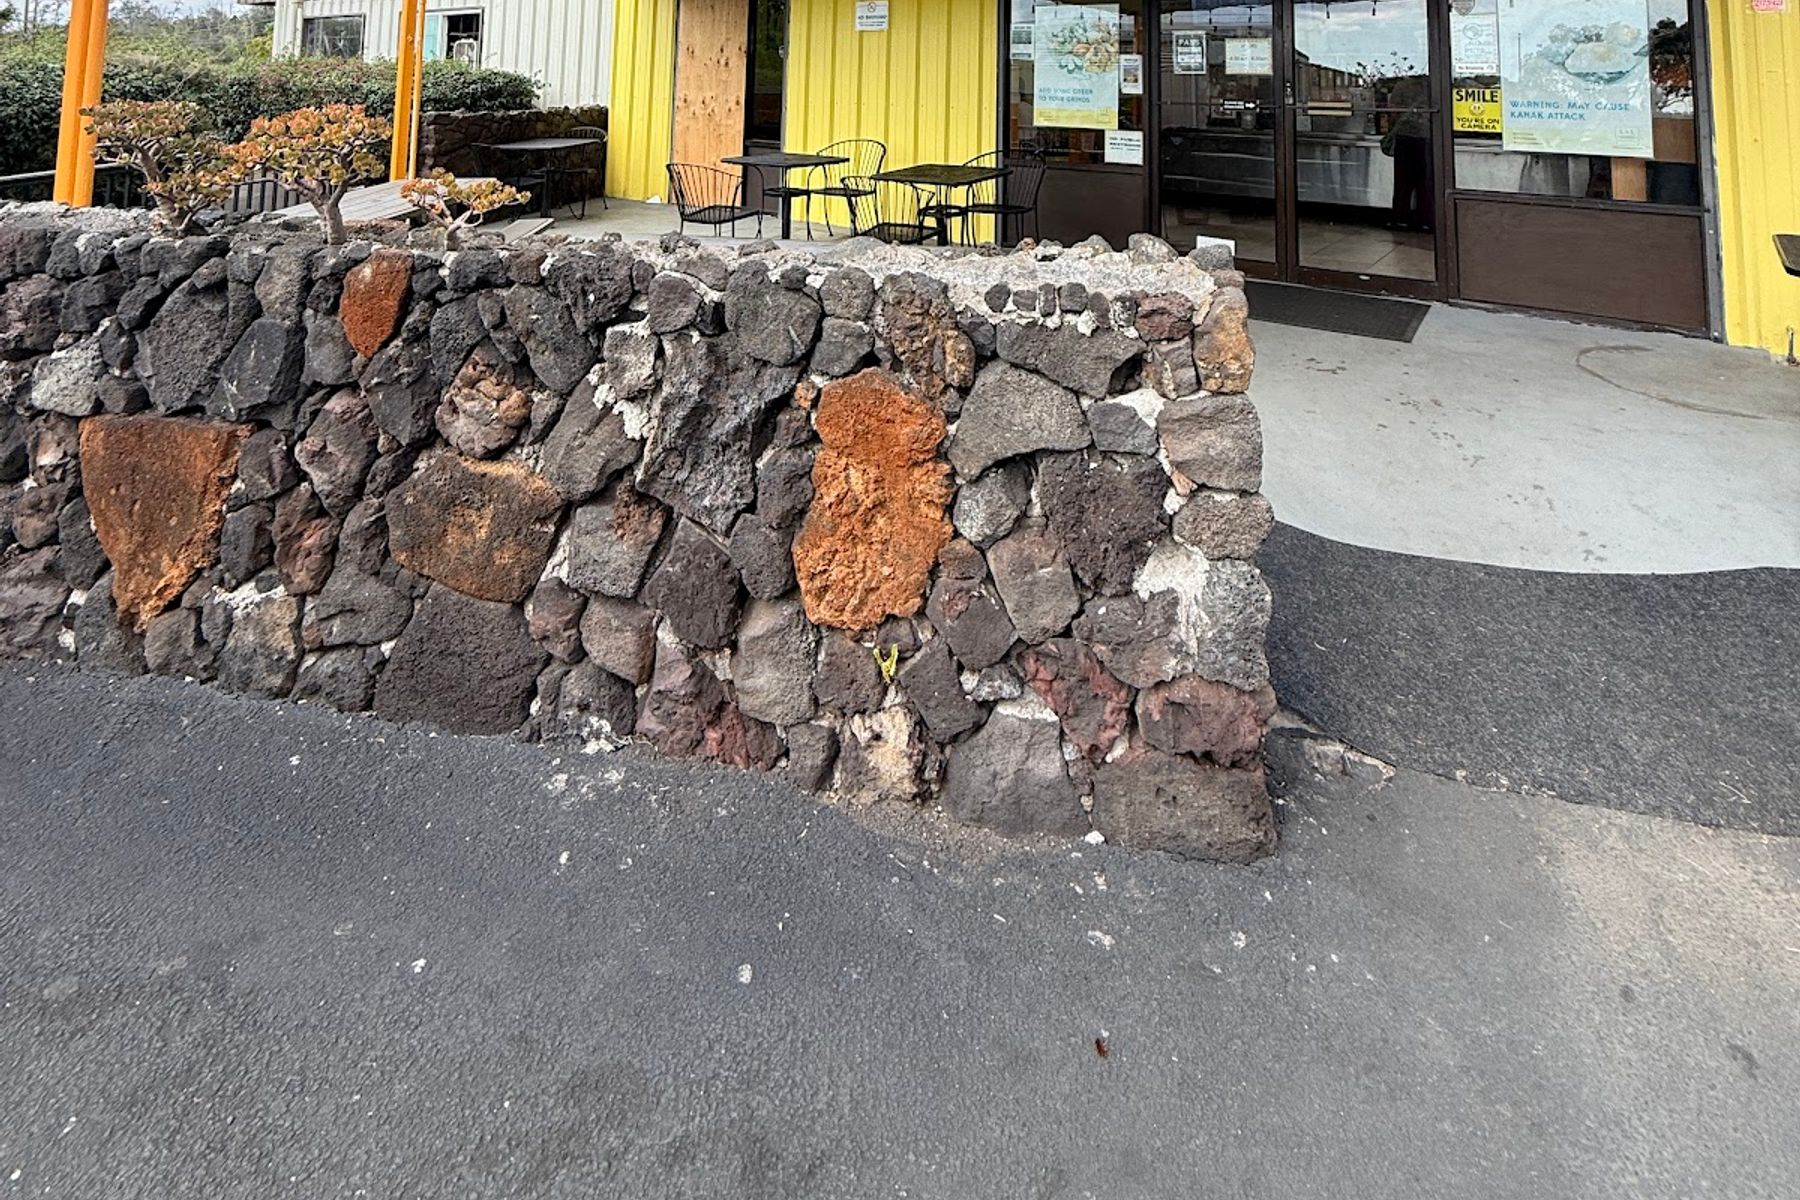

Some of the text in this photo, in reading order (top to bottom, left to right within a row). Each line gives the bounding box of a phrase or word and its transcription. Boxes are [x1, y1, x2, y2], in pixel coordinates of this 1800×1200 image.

[1455, 89, 1499, 103] SMILE
[1509, 100, 1562, 110] WARNING:
[1567, 102, 1590, 110] MAY
[1547, 112, 1586, 121] ATTACK
[1460, 122, 1497, 130] CAMERA
